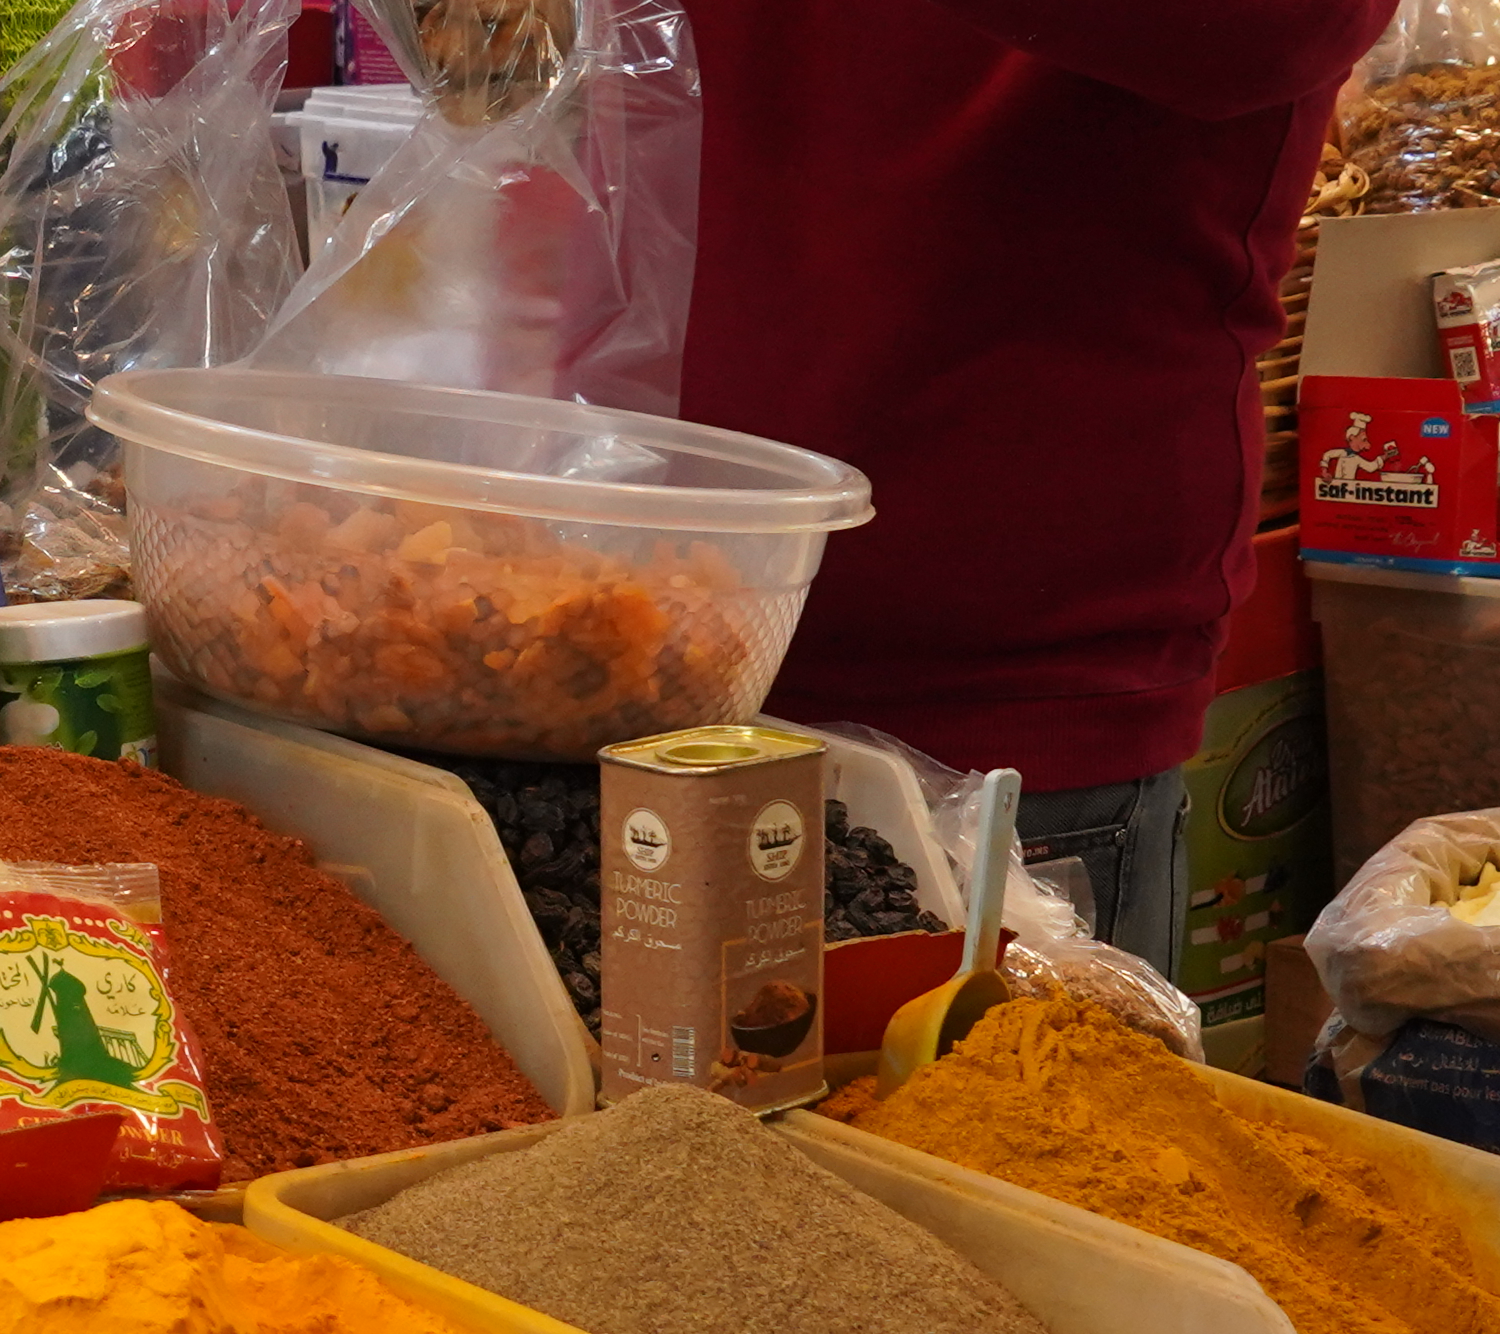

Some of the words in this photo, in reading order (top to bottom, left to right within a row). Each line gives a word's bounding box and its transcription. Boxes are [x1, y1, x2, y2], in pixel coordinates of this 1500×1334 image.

[1423, 423, 1449, 437] NEW
[1318, 481, 1435, 506] saf-instant
[612, 870, 682, 906] TURMERIC
[615, 897, 678, 930] POWDER
[750, 916, 803, 944] POWDER
[96, 971, 137, 999] كاري
[1452, 1083, 1482, 1101] pour
